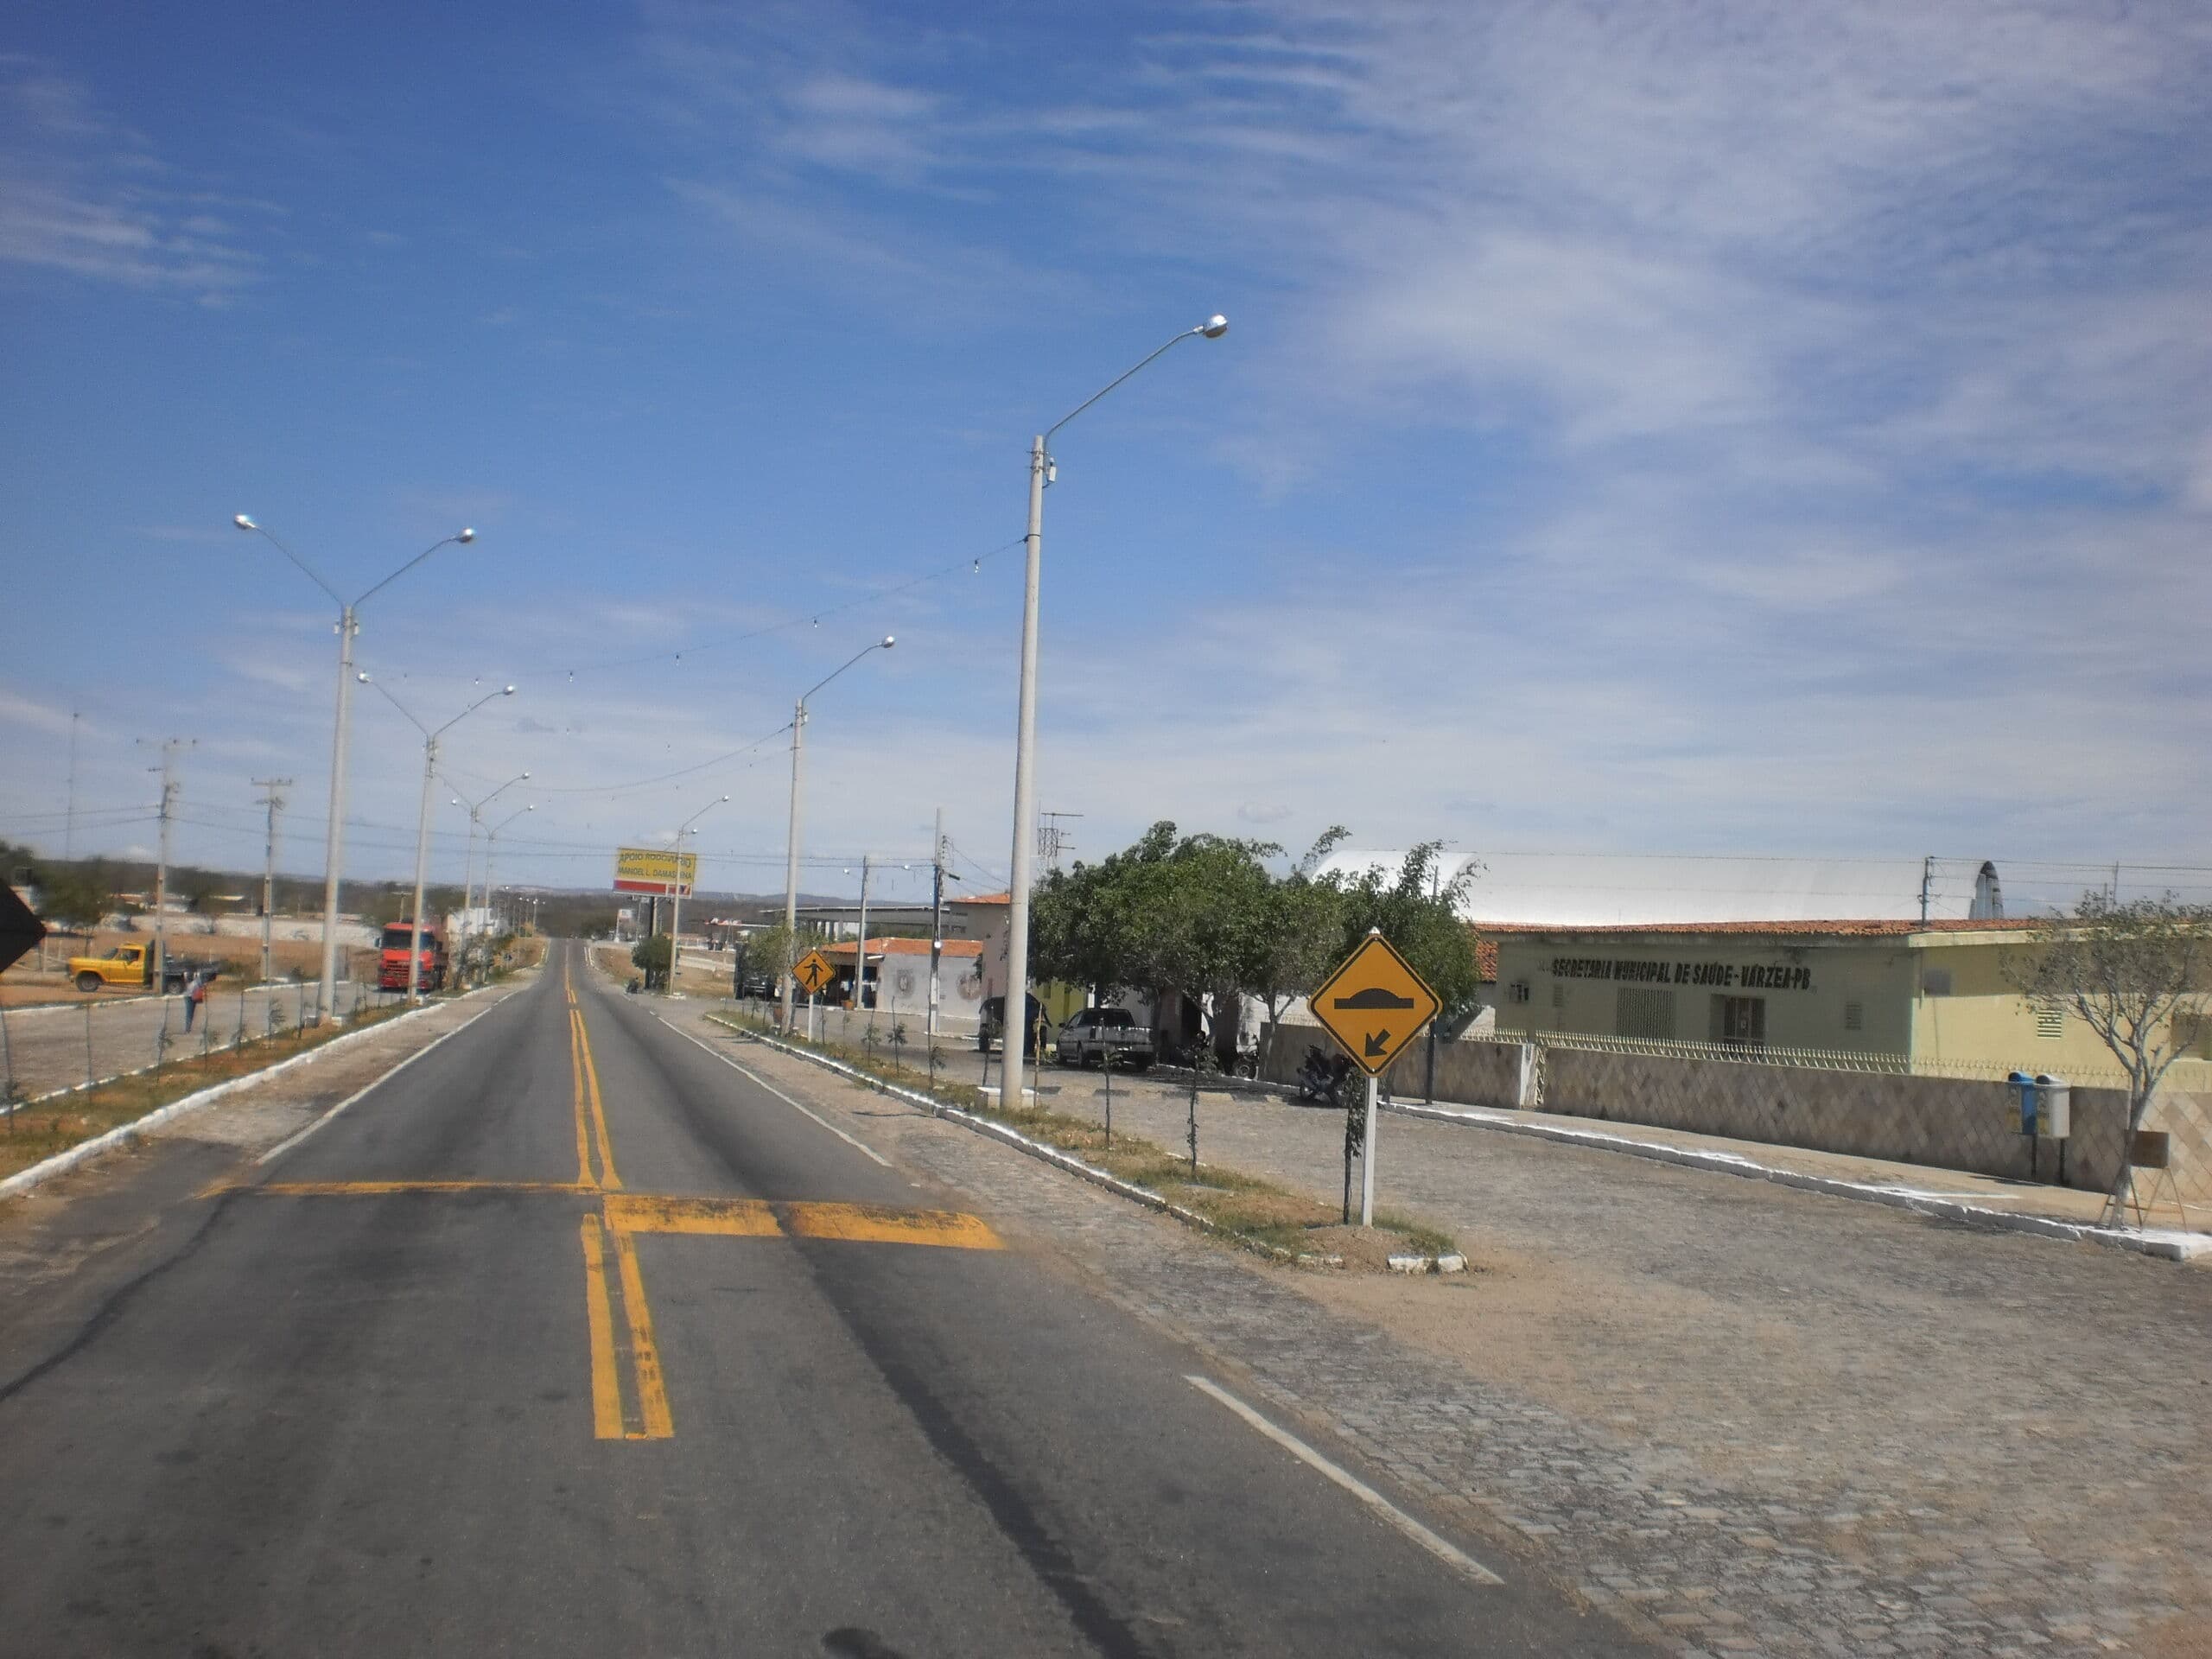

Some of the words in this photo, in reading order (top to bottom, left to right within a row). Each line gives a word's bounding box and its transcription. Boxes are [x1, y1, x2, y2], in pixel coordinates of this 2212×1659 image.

[1553, 957, 1613, 980] SECRETARIA
[1614, 960, 1671, 983] MUNICIPAL
[1675, 963, 1691, 984] DE
